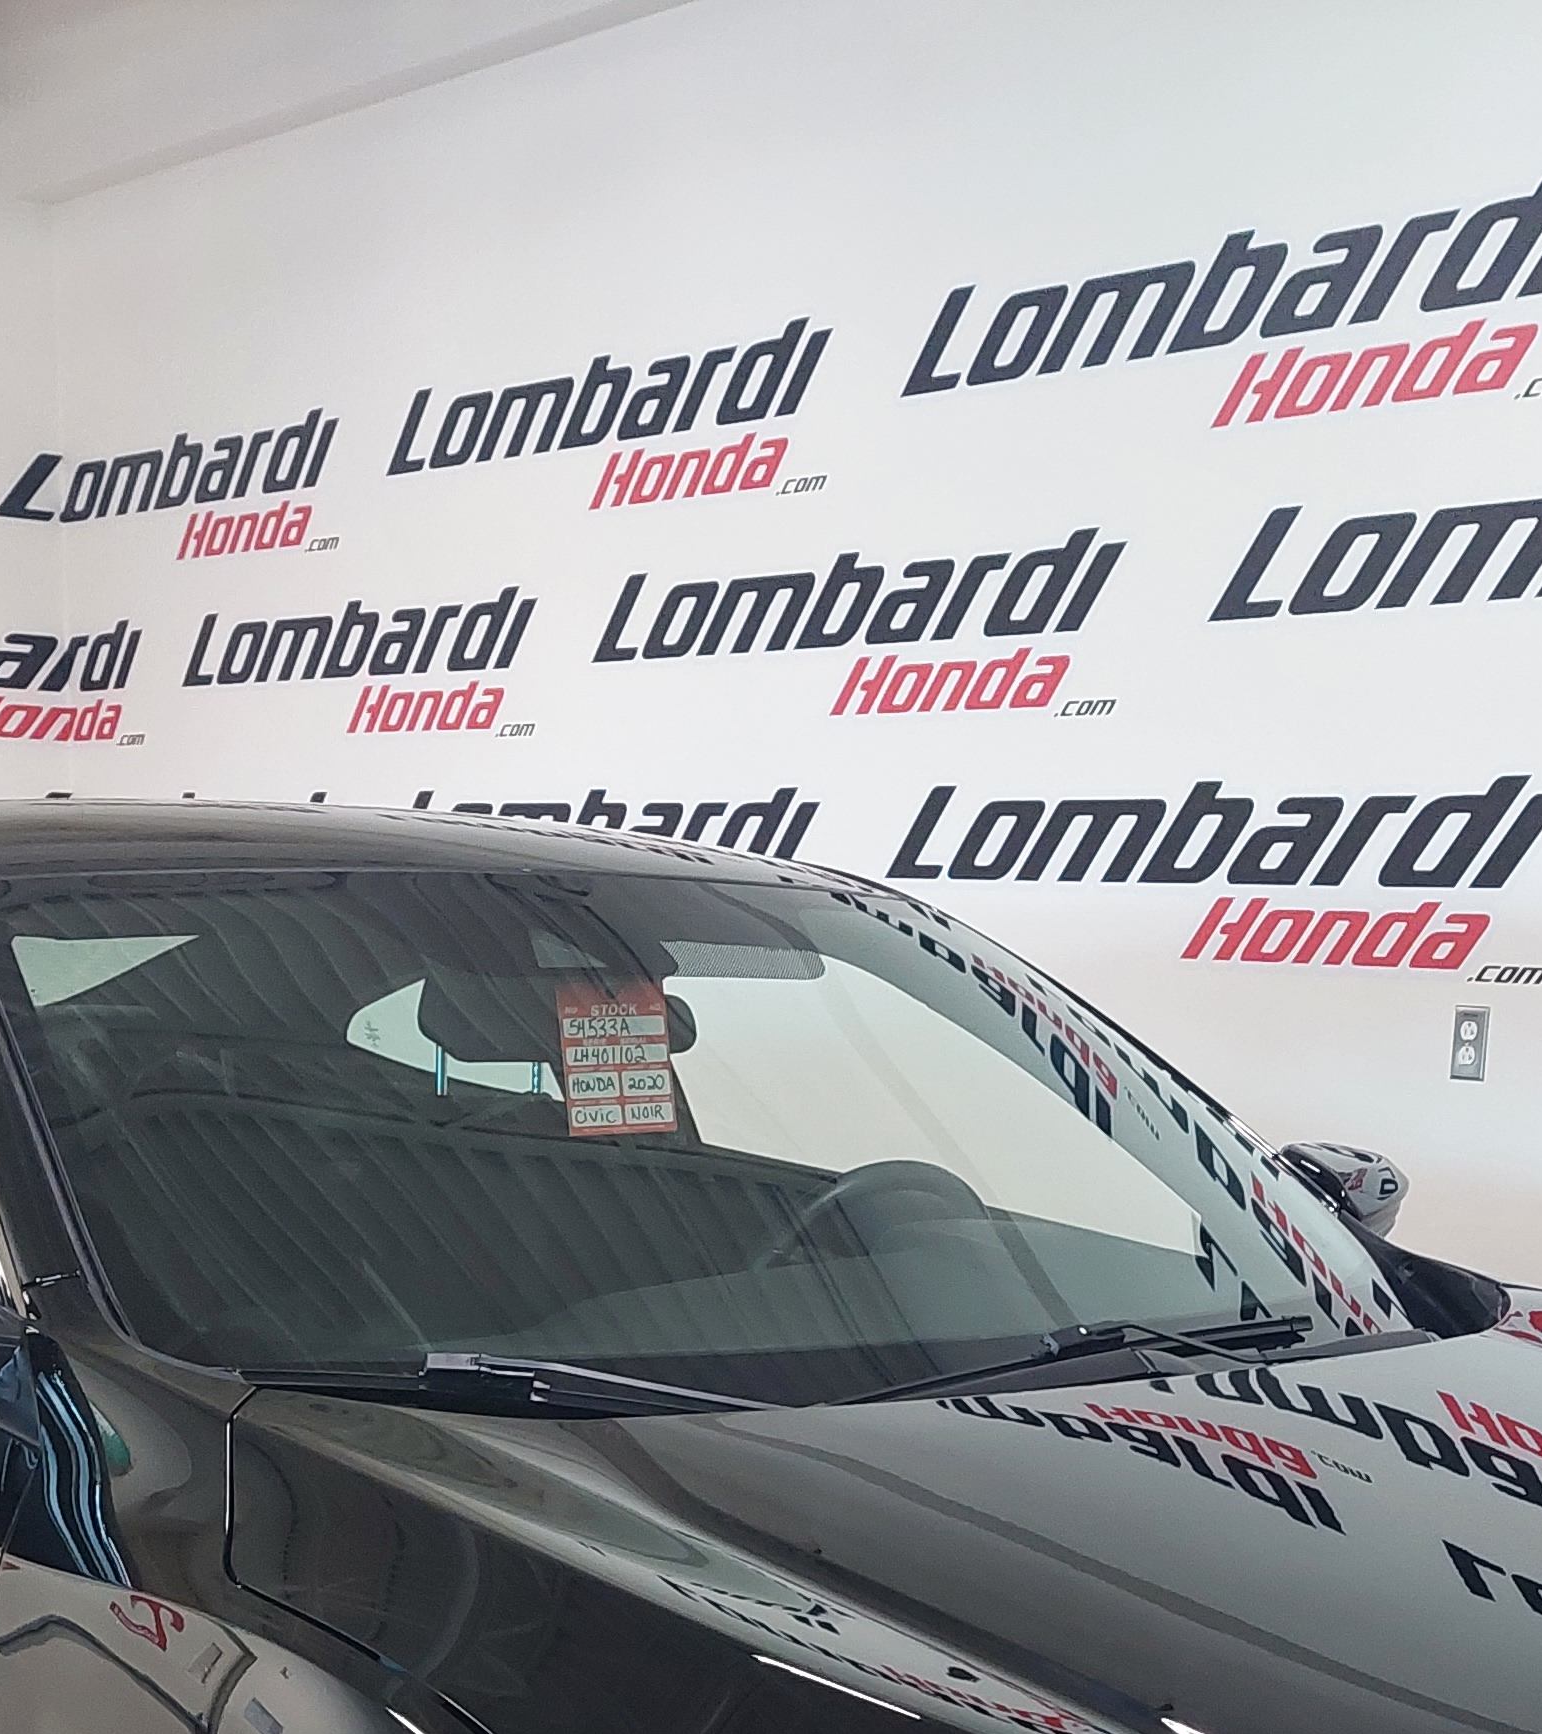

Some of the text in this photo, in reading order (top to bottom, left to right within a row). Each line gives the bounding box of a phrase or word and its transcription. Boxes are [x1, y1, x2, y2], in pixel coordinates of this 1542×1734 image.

[387, 318, 831, 475] Lombardi
[1213, 320, 1538, 427] Honda
[590, 433, 788, 509] Honda
[178, 502, 311, 560] Honda
[593, 528, 1126, 662] Lombardi
[183, 587, 536, 686] Lombardi
[348, 681, 504, 733] Honda
[831, 648, 1070, 715] Honda
[1182, 898, 1490, 970] Honda
[590, 1003, 637, 1016] STOCK
[572, 1074, 665, 1093] HONDA 2020
[631, 1104, 665, 1120] NOIR
